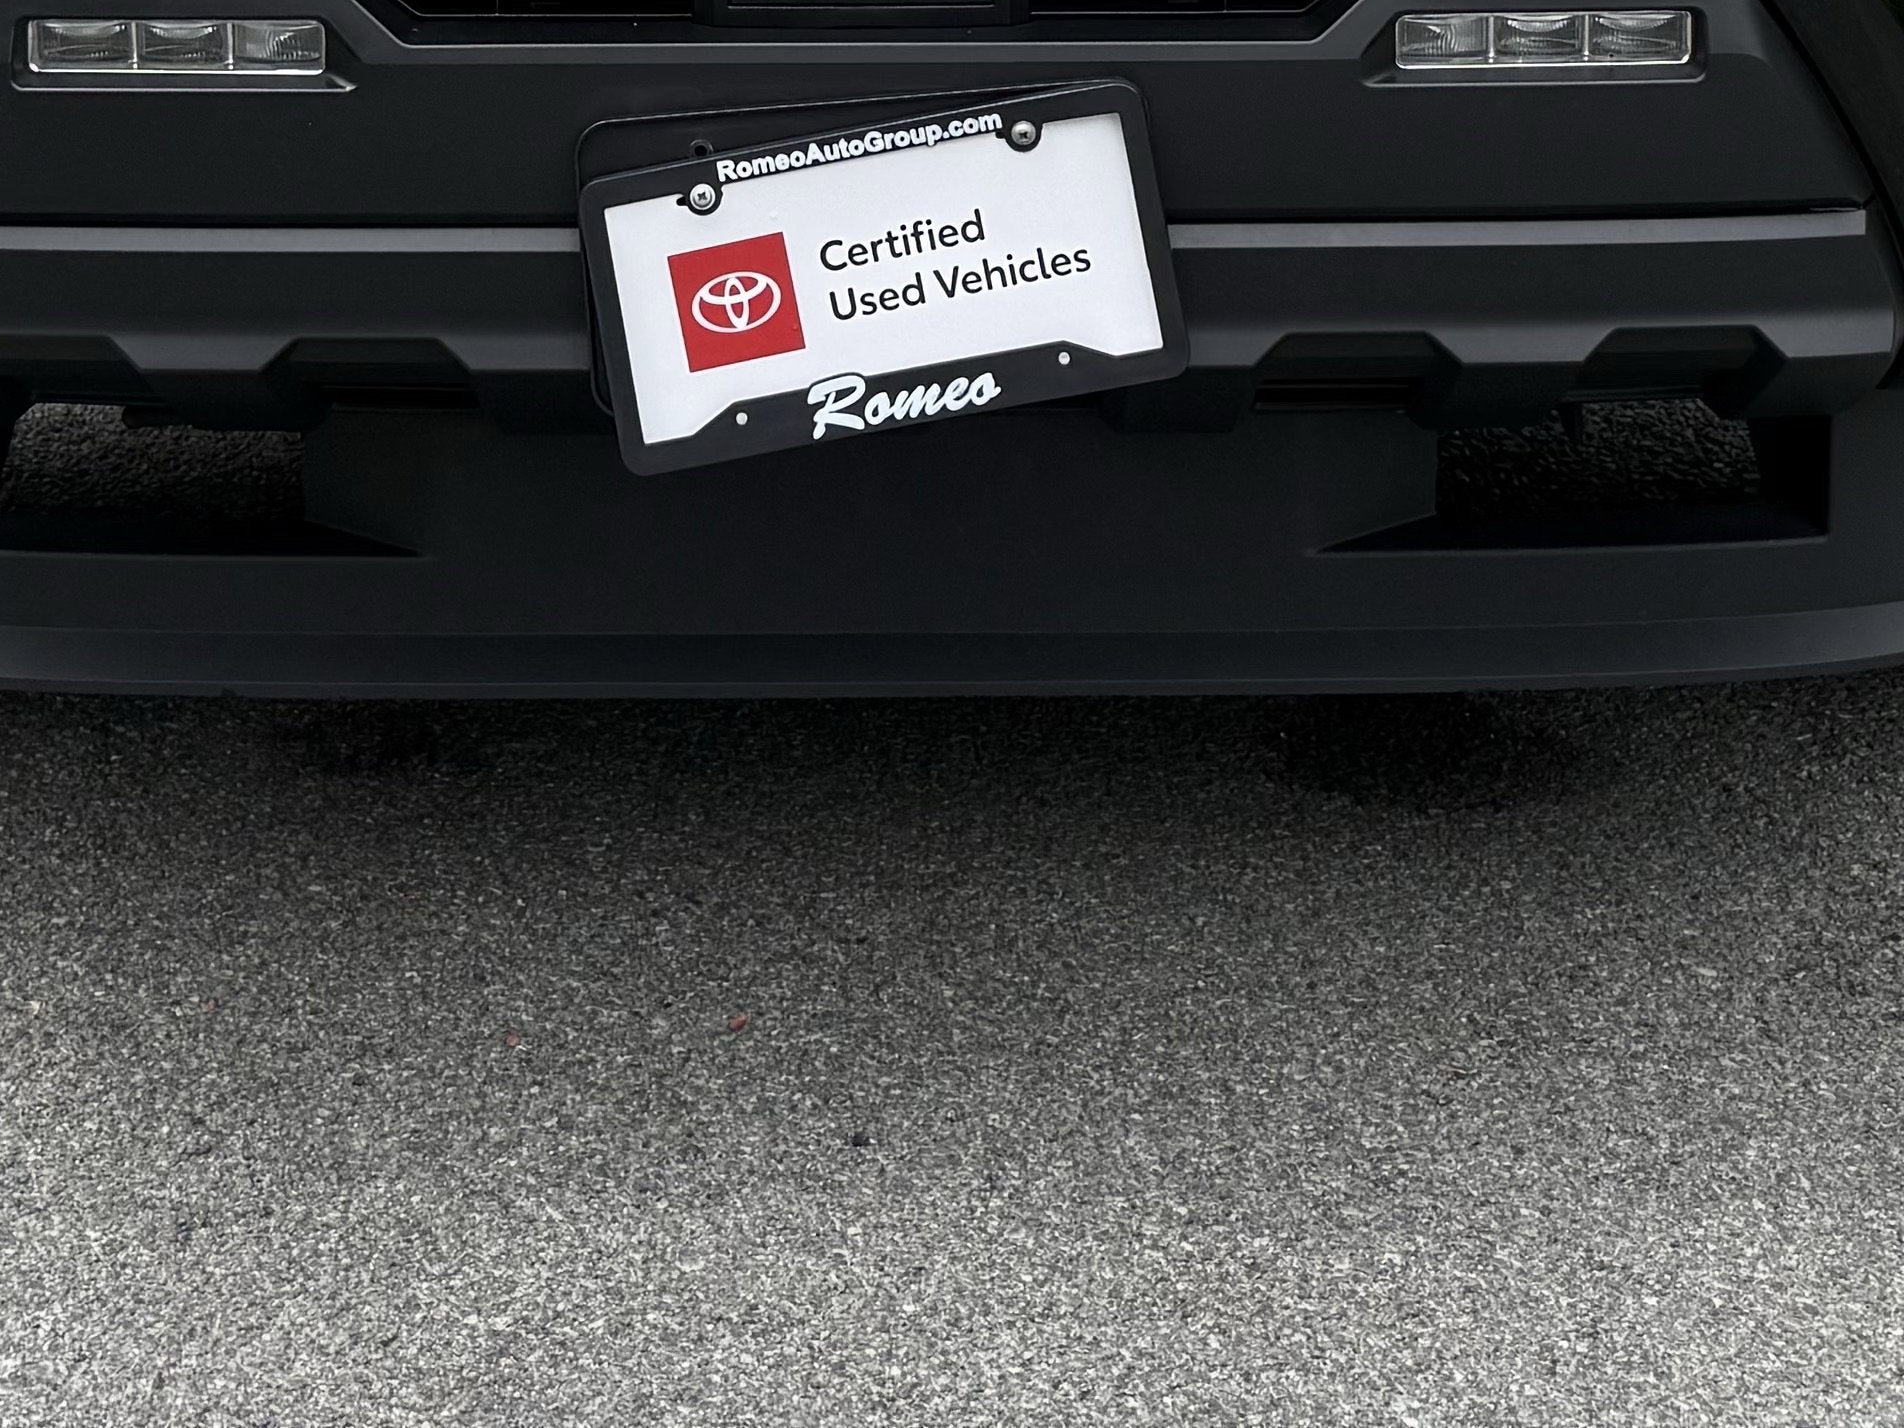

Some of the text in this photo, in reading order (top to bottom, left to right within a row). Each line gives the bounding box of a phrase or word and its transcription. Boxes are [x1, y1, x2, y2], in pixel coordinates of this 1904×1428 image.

[716, 112, 1003, 182] RomeoAutoGroup.com
[819, 208, 986, 272] Certified
[829, 245, 1092, 321] Used Vehicles
[807, 370, 1002, 441] Romeo
